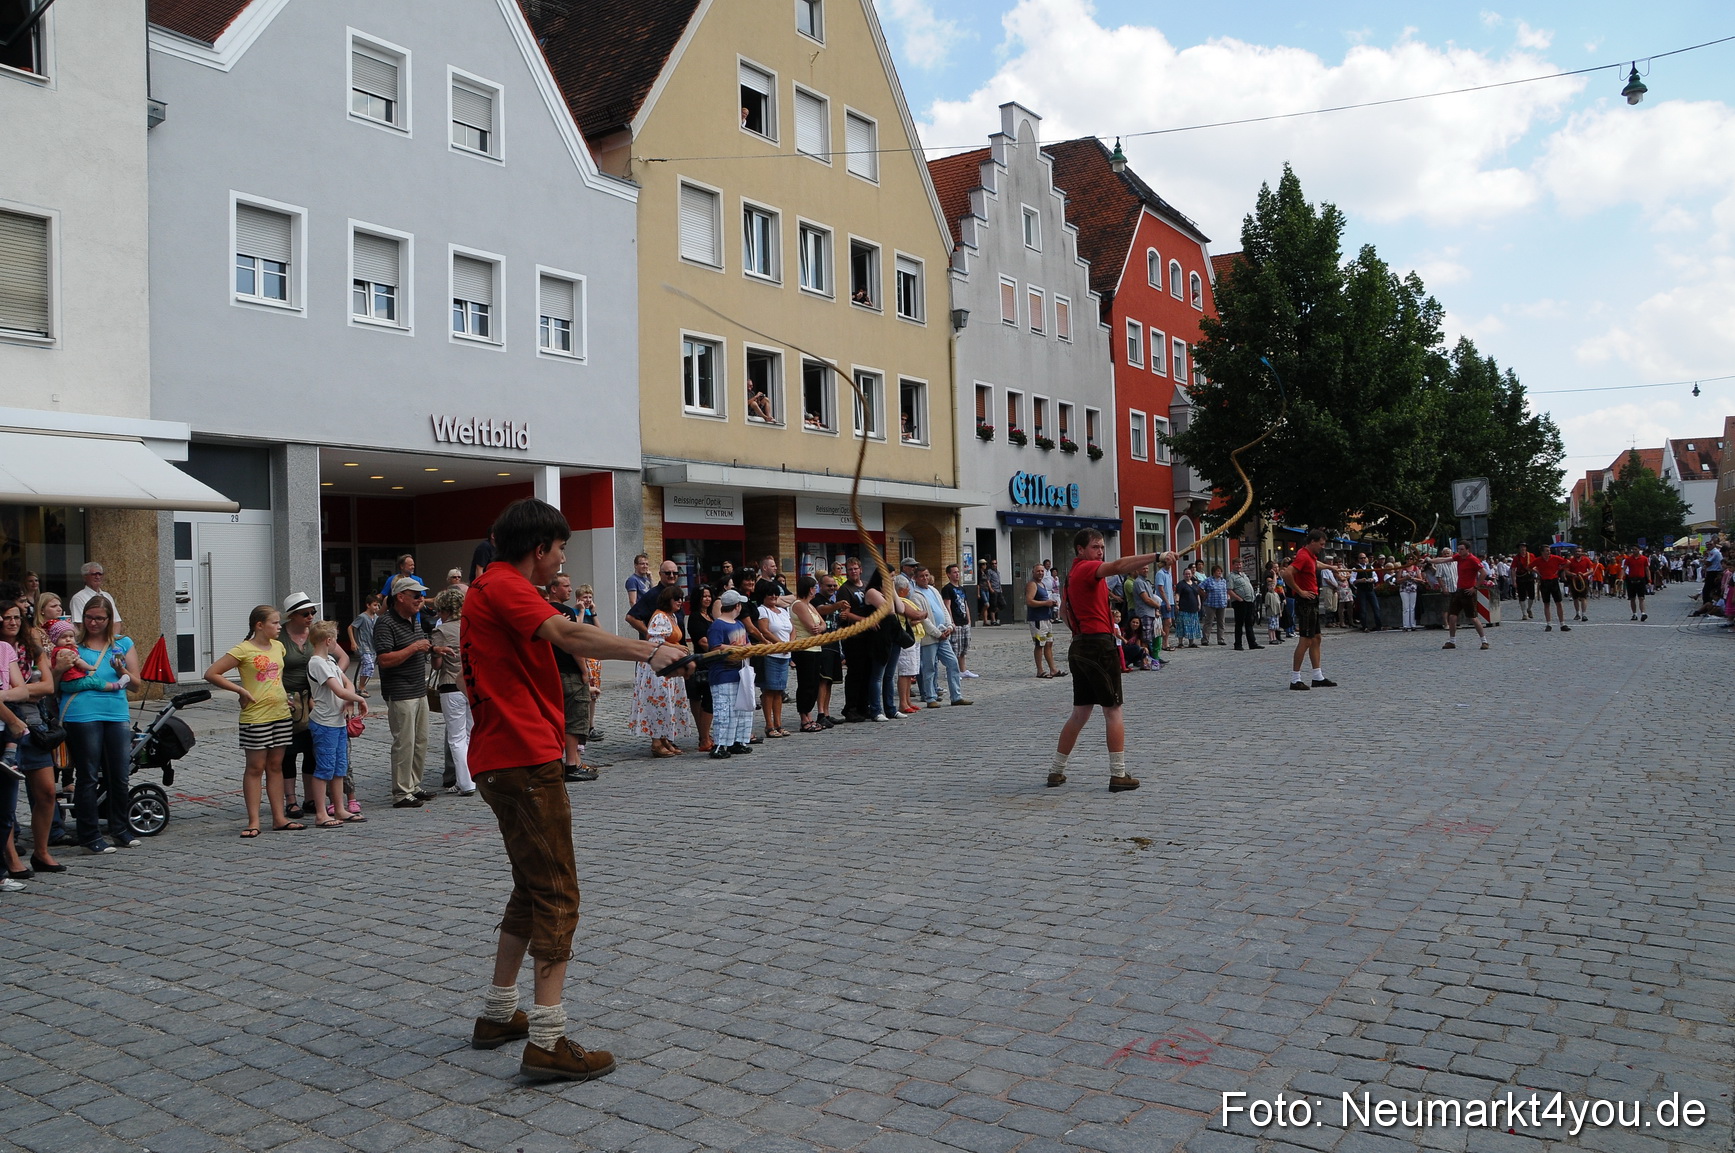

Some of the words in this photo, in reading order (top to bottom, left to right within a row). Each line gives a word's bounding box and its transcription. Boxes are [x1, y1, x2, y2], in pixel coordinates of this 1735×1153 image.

[430, 414, 531, 450] Weltbild
[1009, 470, 1067, 507] Eilles
[673, 496, 705, 506] Reissinger
[705, 498, 722, 507] Optik
[705, 509, 733, 518] CENTRUM
[815, 505, 839, 515] Reissinger
[230, 514, 239, 522] 29
